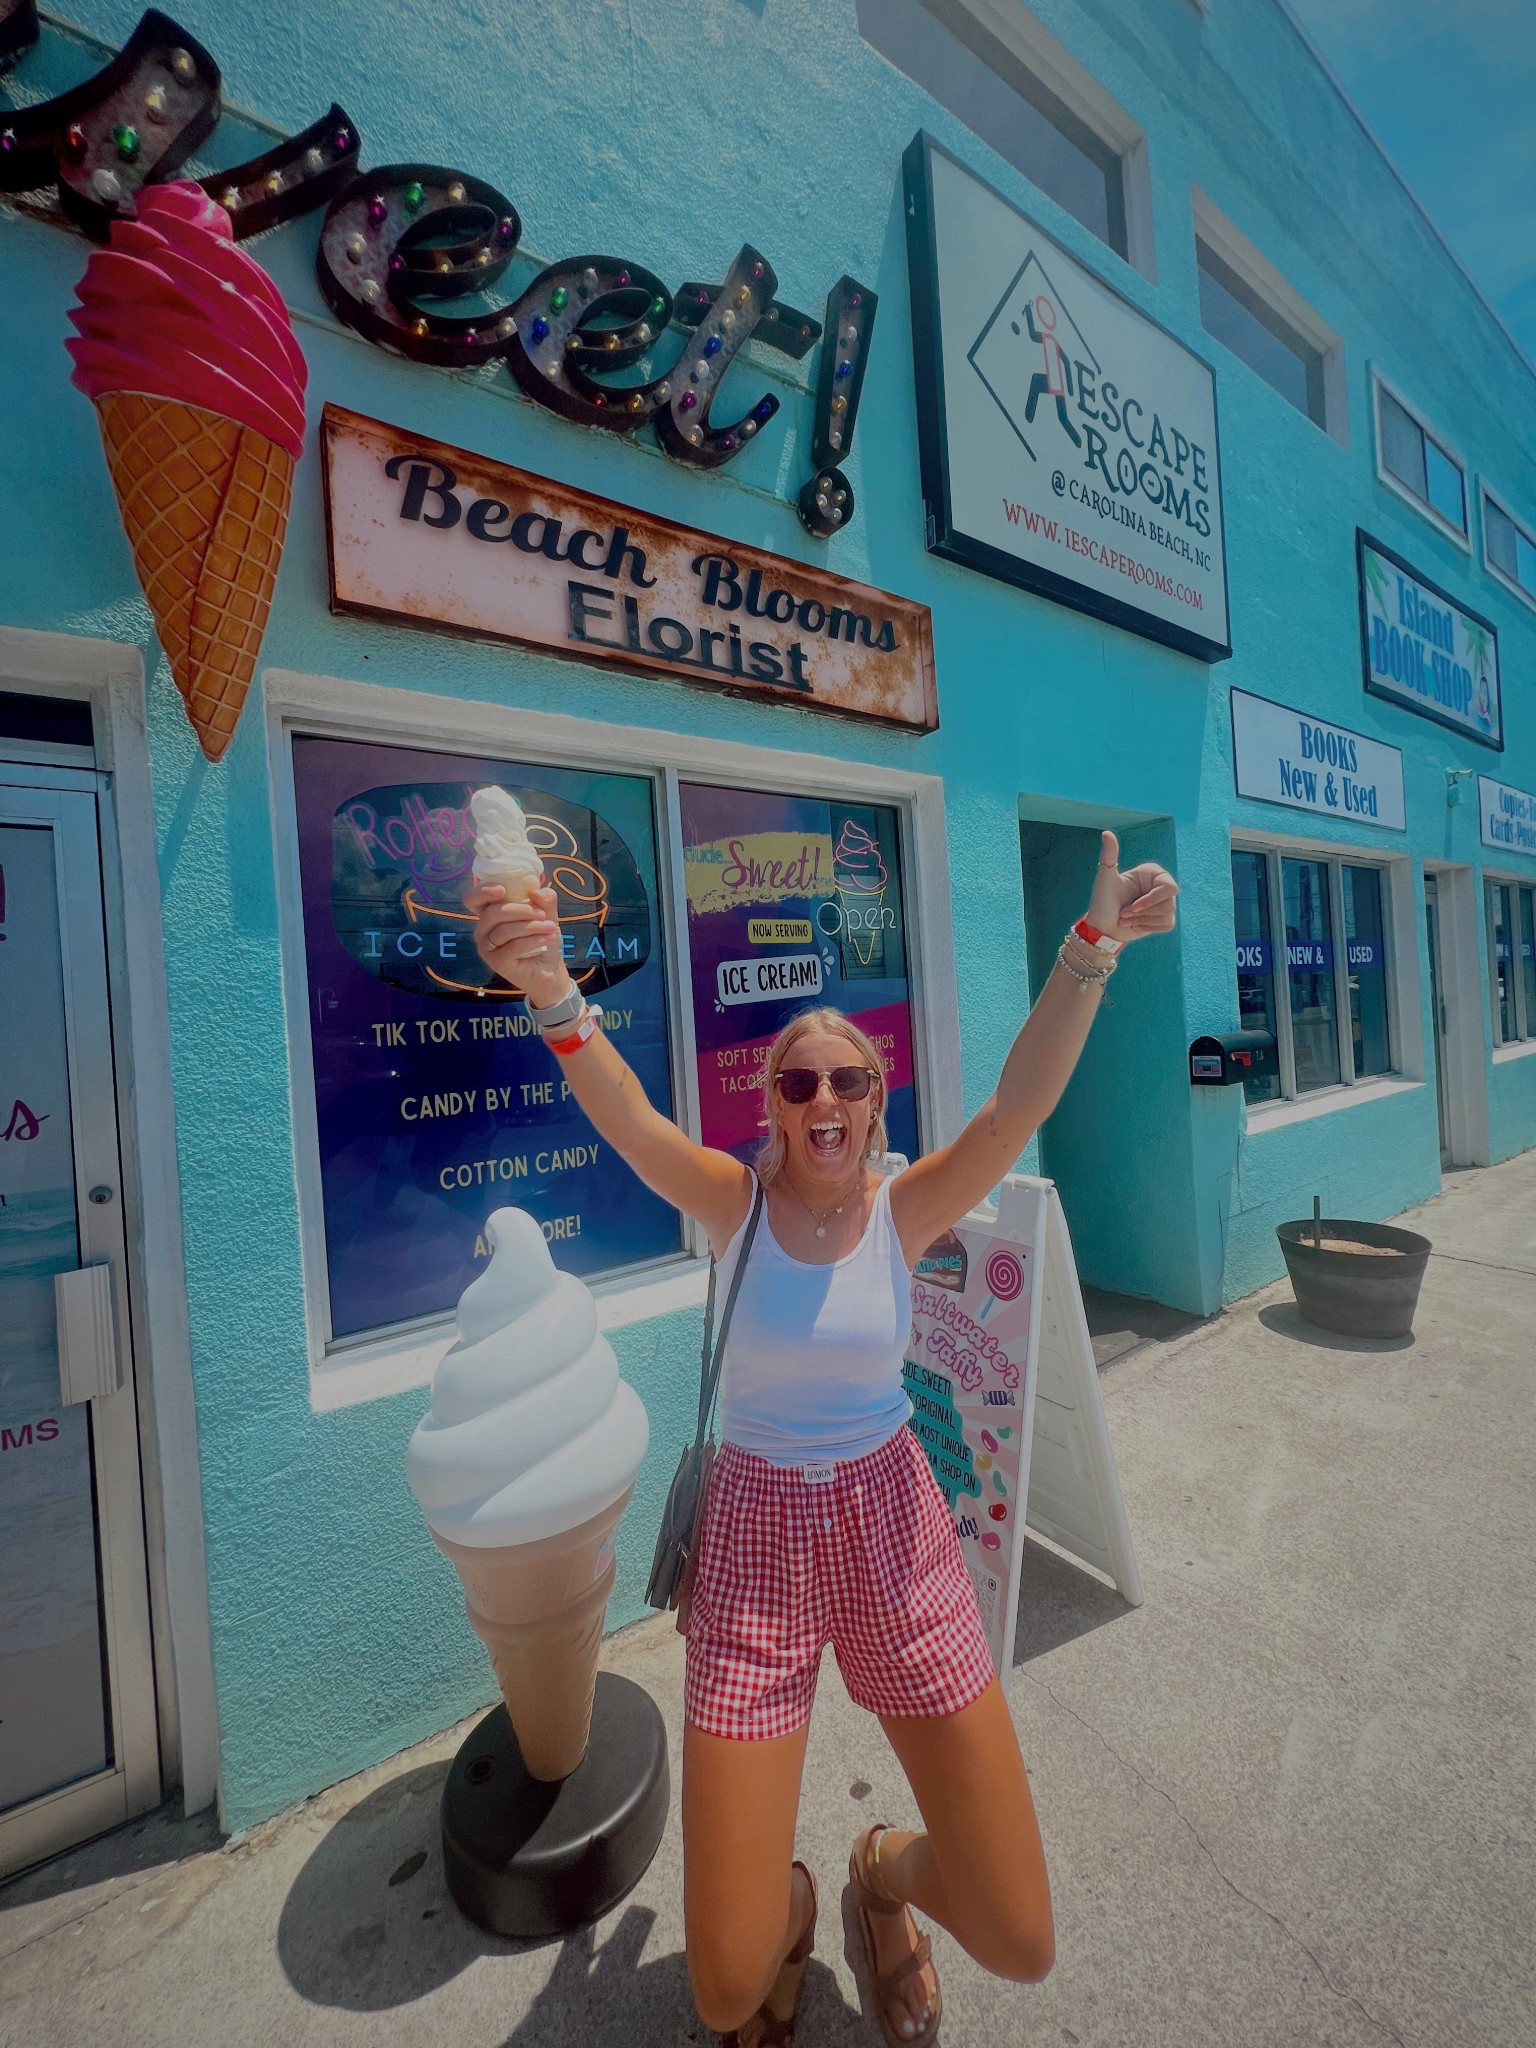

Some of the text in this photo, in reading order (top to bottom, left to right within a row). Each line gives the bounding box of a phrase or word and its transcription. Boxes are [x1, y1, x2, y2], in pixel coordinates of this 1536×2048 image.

[1082, 423, 1212, 538] ROOMS
[1069, 479, 1147, 538] CAROLINA
[1149, 521, 1194, 564] BEACH,
[1195, 548, 1212, 573] NC
[384, 454, 901, 654] Beach Blooms
[567, 580, 814, 695] Florist
[1396, 574, 1455, 657] Island
[1373, 614, 1473, 717] BOOK SHOP
[1299, 721, 1359, 774] BOOKS
[1278, 758, 1378, 818] New & Used
[721, 839, 821, 891] Sweet!
[752, 922, 809, 939] NOW SERVING
[816, 901, 897, 944] Open
[363, 931, 640, 961] ICE EAM
[1236, 946, 1373, 968] OKS NEW & USED
[722, 959, 818, 995] ICE CREAM!
[372, 1009, 633, 1048] TIK TOK TRENDI NDY
[717, 1049, 748, 1068] SOFT
[400, 1090, 478, 1121] CANDY
[486, 1086, 512, 1112] BY
[520, 1082, 554, 1107] THE
[439, 1143, 600, 1190] COTTON CANDY
[542, 1214, 582, 1241] ORE!
[911, 1284, 1020, 1389] Saltwater
[926, 1327, 984, 1392] Taffy
[915, 1393, 956, 1431] ORIGINAL
[920, 1422, 939, 1445] MOST
[941, 1433, 971, 1463] UNIQUE
[940, 1458, 962, 1482] SHOP
[963, 1471, 976, 1492] ON
